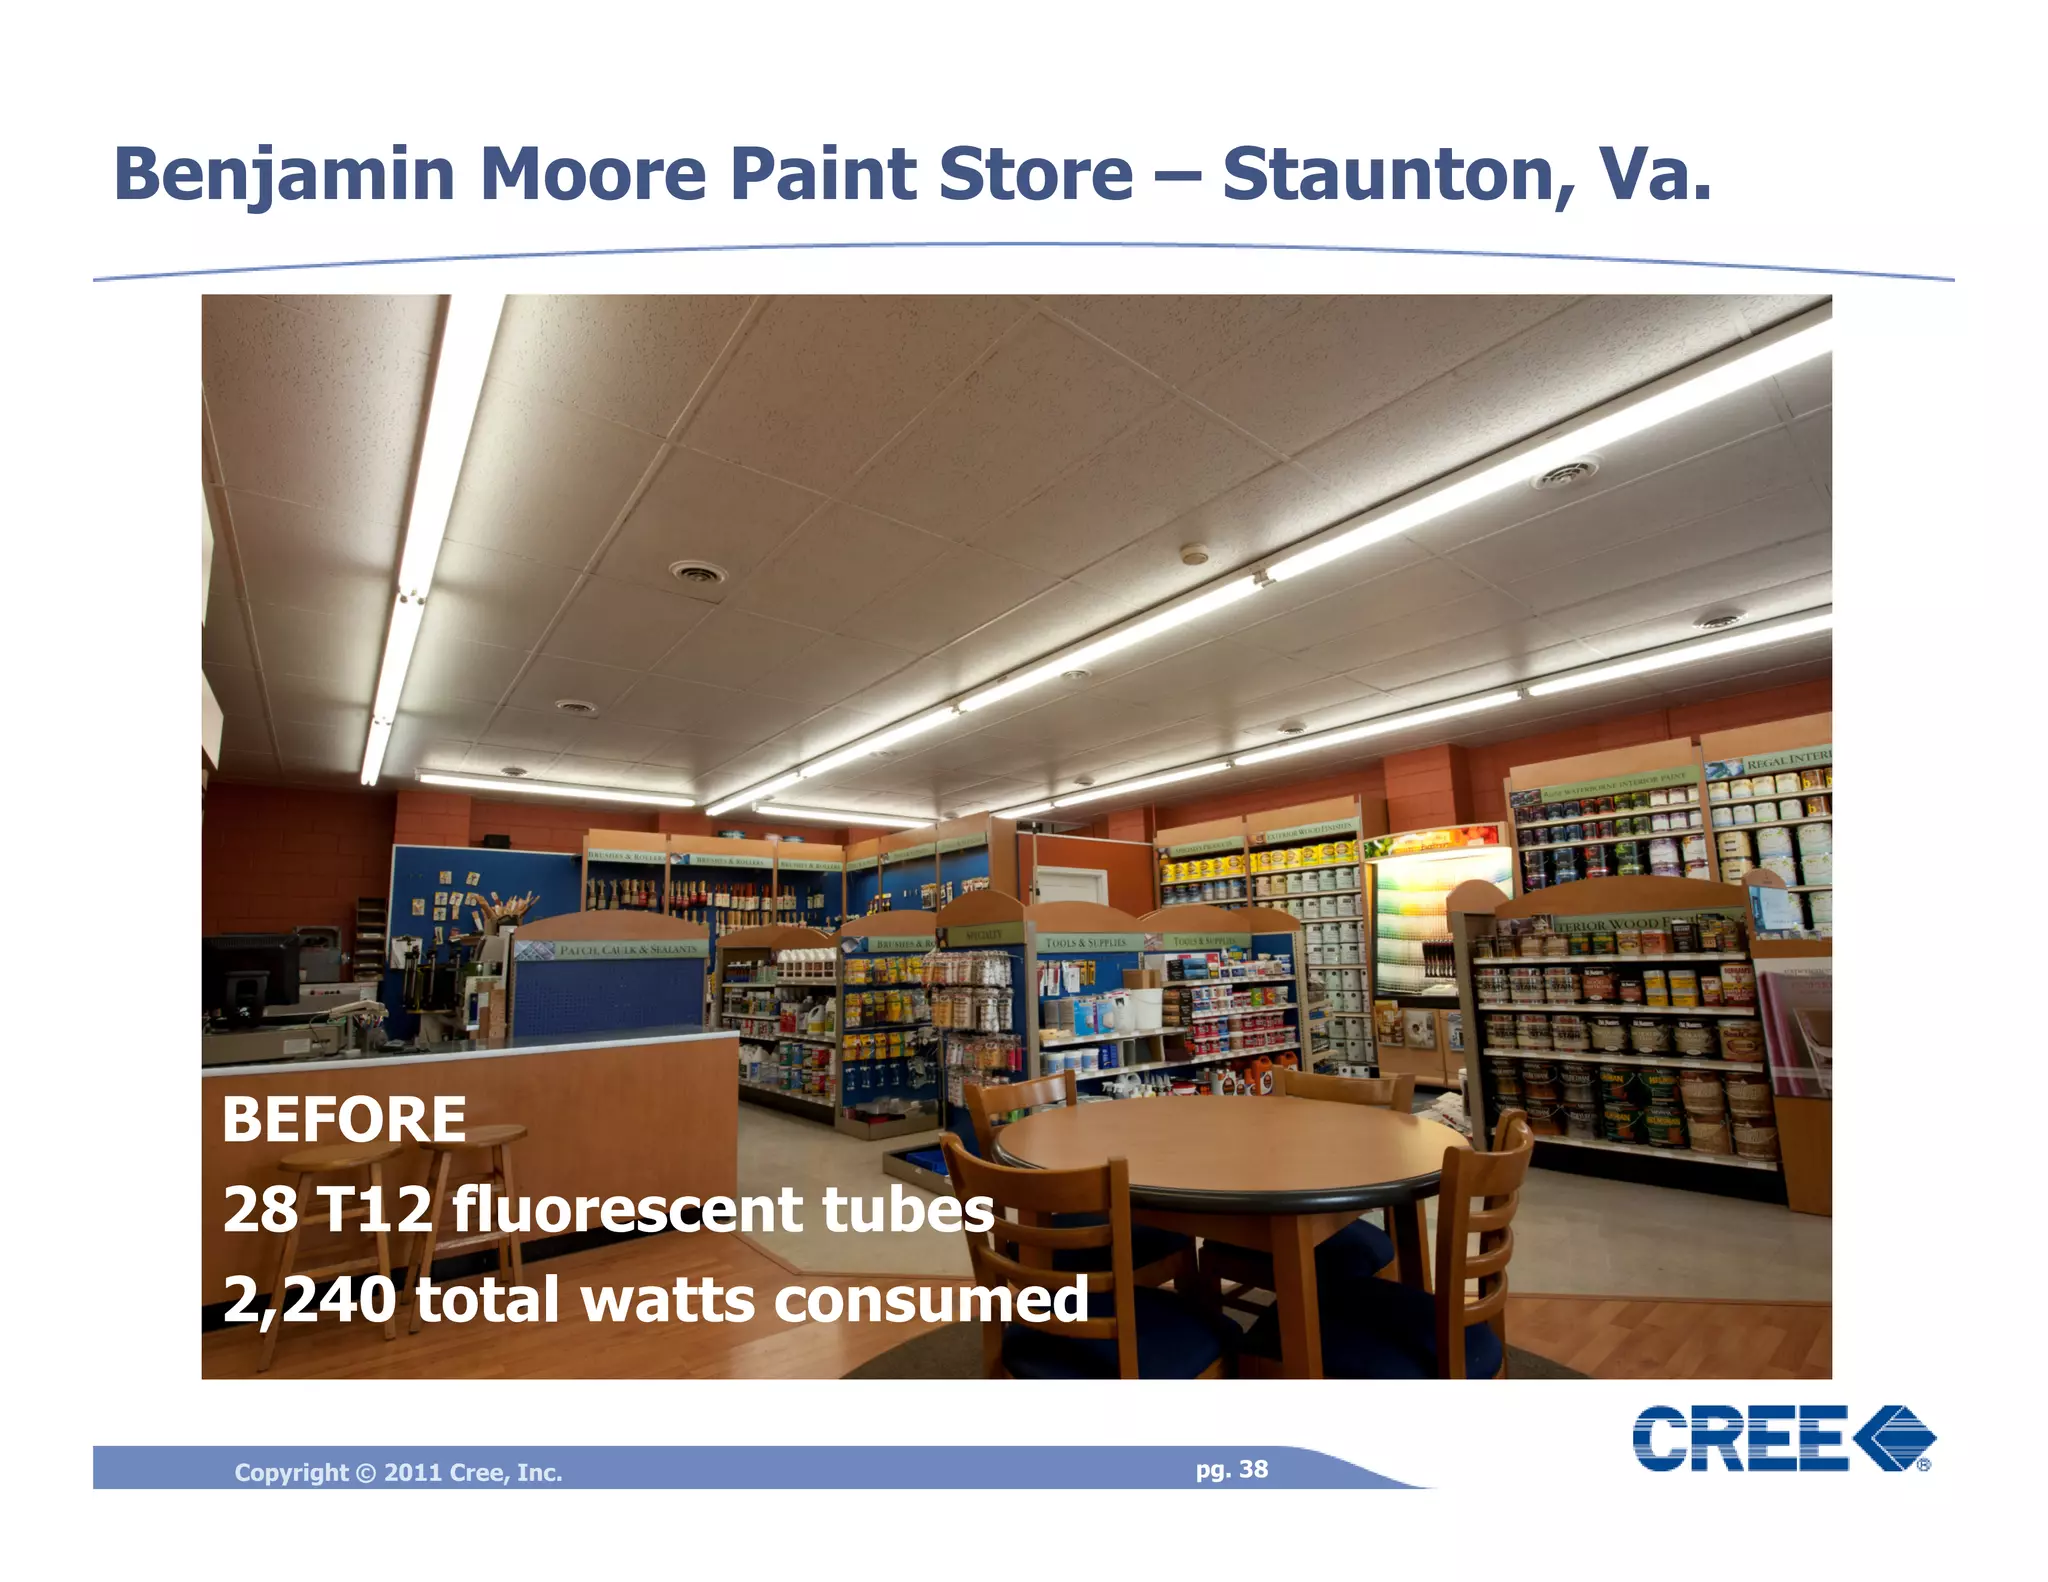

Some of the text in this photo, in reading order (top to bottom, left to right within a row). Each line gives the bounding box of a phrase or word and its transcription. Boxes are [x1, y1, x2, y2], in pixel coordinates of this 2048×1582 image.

[1748, 757, 1788, 770] REGAL
[1619, 776, 1658, 789] INTERIOR
[1660, 772, 1687, 783] PAINT
[1267, 823, 1352, 841] EXTERIOR WOOD FINISHES
[588, 851, 624, 860] BRUSHES
[634, 854, 666, 862] ROLLERS
[1555, 920, 1606, 933] TERIOR
[1609, 918, 1659, 930] WOOD
[966, 929, 1003, 941] SPECIALTY
[1174, 936, 1236, 946] TOOLS & SUPPLIES
[877, 939, 915, 949] BRUSHES
[916, 939, 922, 947] &
[1046, 937, 1127, 949] TOOLS & SUPPLIES
[560, 943, 698, 956] PATCH, CAULK & SEALANTS
